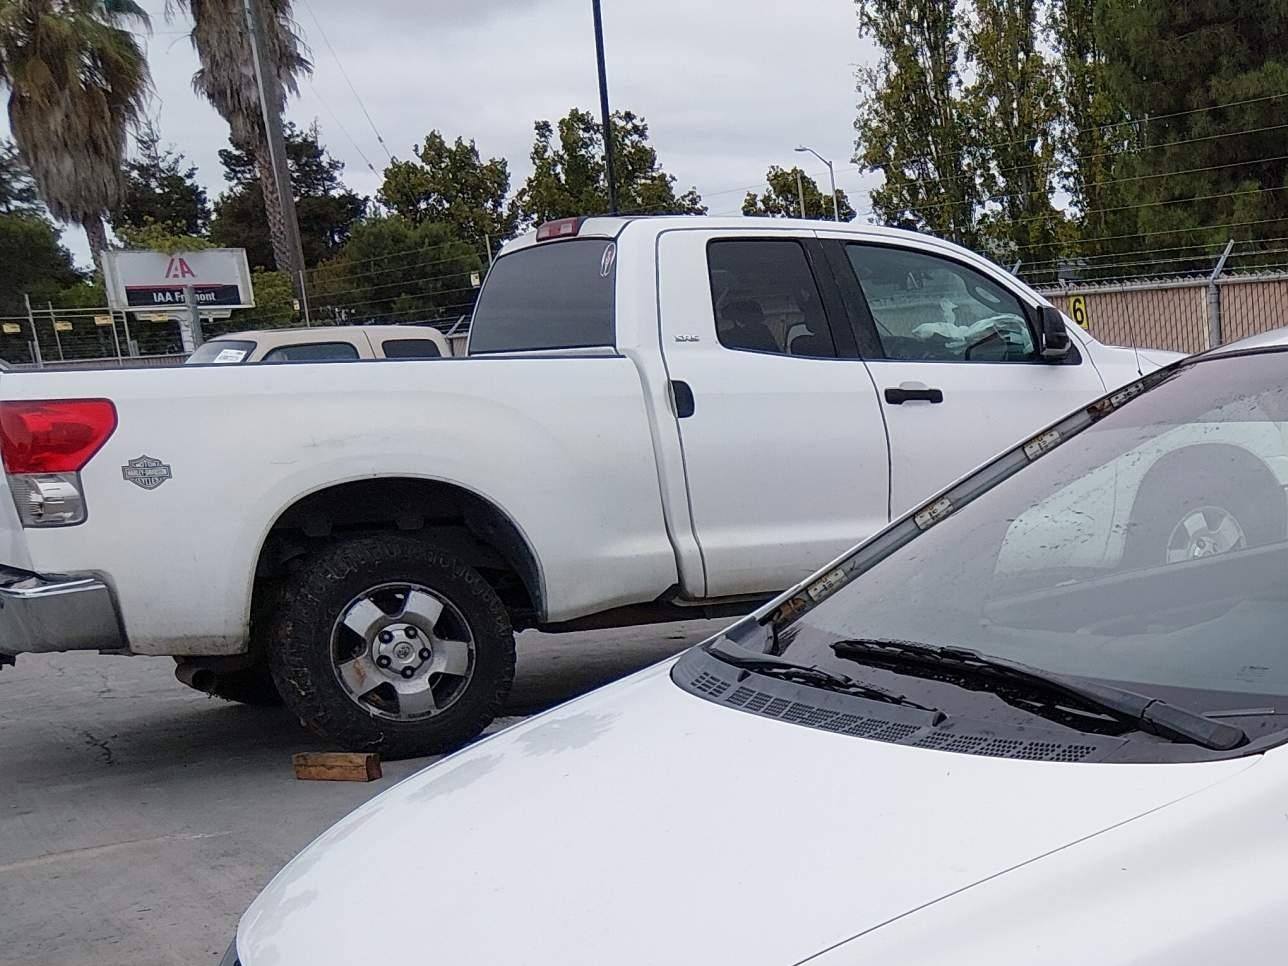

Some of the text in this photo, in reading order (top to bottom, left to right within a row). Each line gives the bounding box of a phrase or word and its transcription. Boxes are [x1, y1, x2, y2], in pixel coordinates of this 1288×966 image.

[153, 291, 216, 303] IAA Front
[1072, 297, 1085, 325] 6
